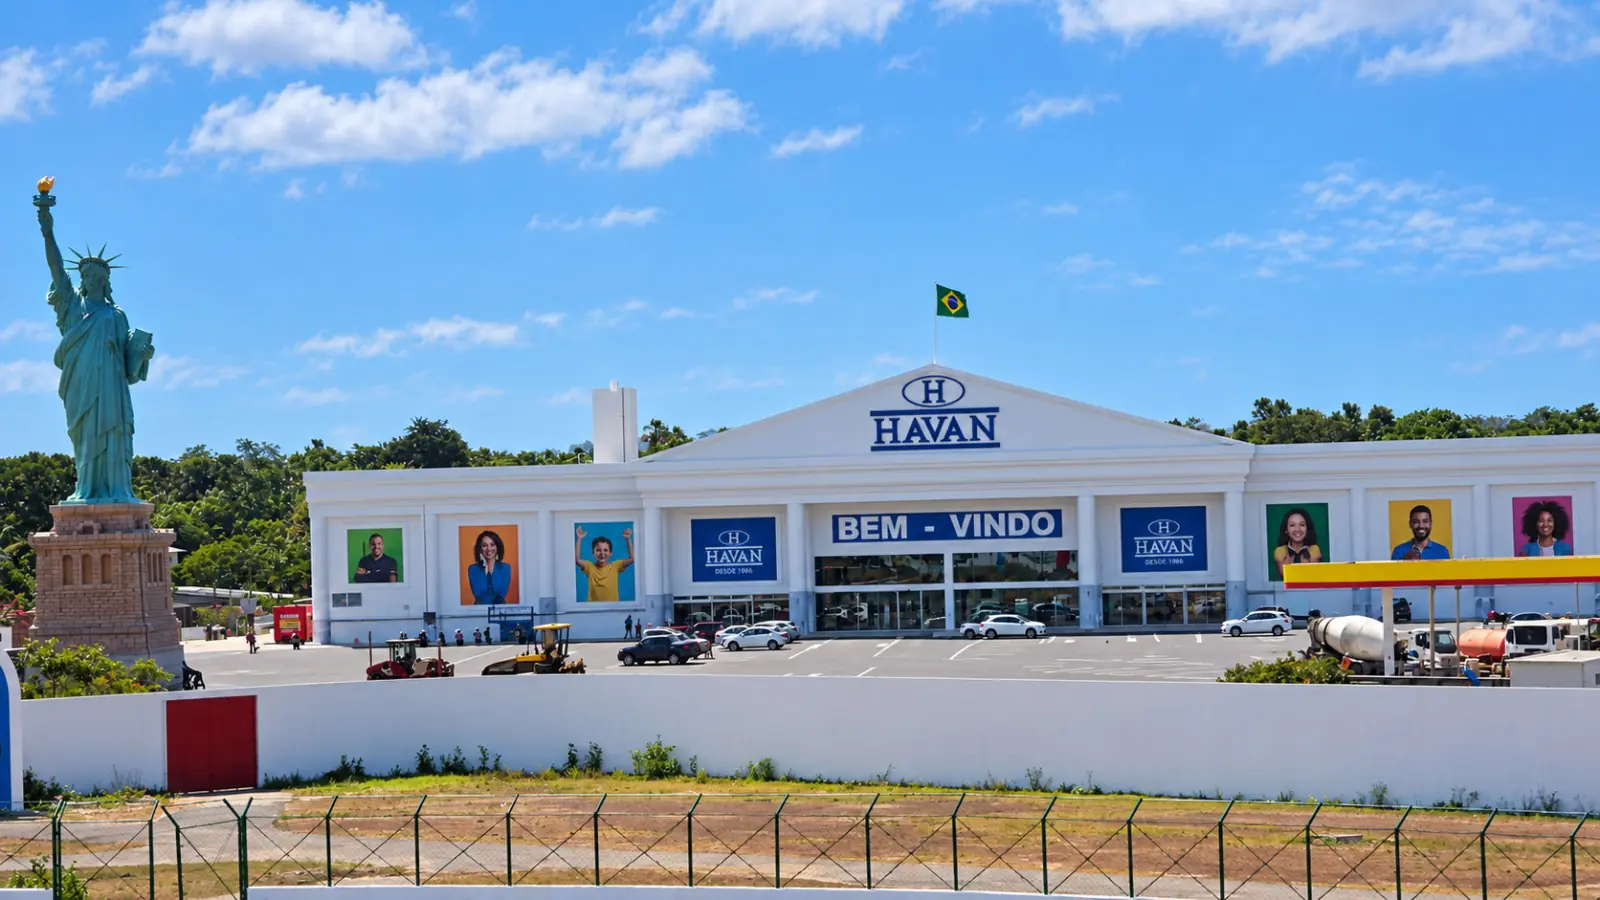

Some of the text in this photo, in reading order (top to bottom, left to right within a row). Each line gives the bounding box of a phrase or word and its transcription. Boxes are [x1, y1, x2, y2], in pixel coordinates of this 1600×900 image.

[922, 380, 946, 404] H
[873, 414, 997, 444] HAVAN
[838, 515, 908, 540] BEM
[949, 512, 1055, 537] VINDO
[1158, 521, 1170, 533] H
[728, 532, 740, 544] H
[1135, 540, 1192, 554] HAVAN
[706, 550, 762, 563] HAVAN
